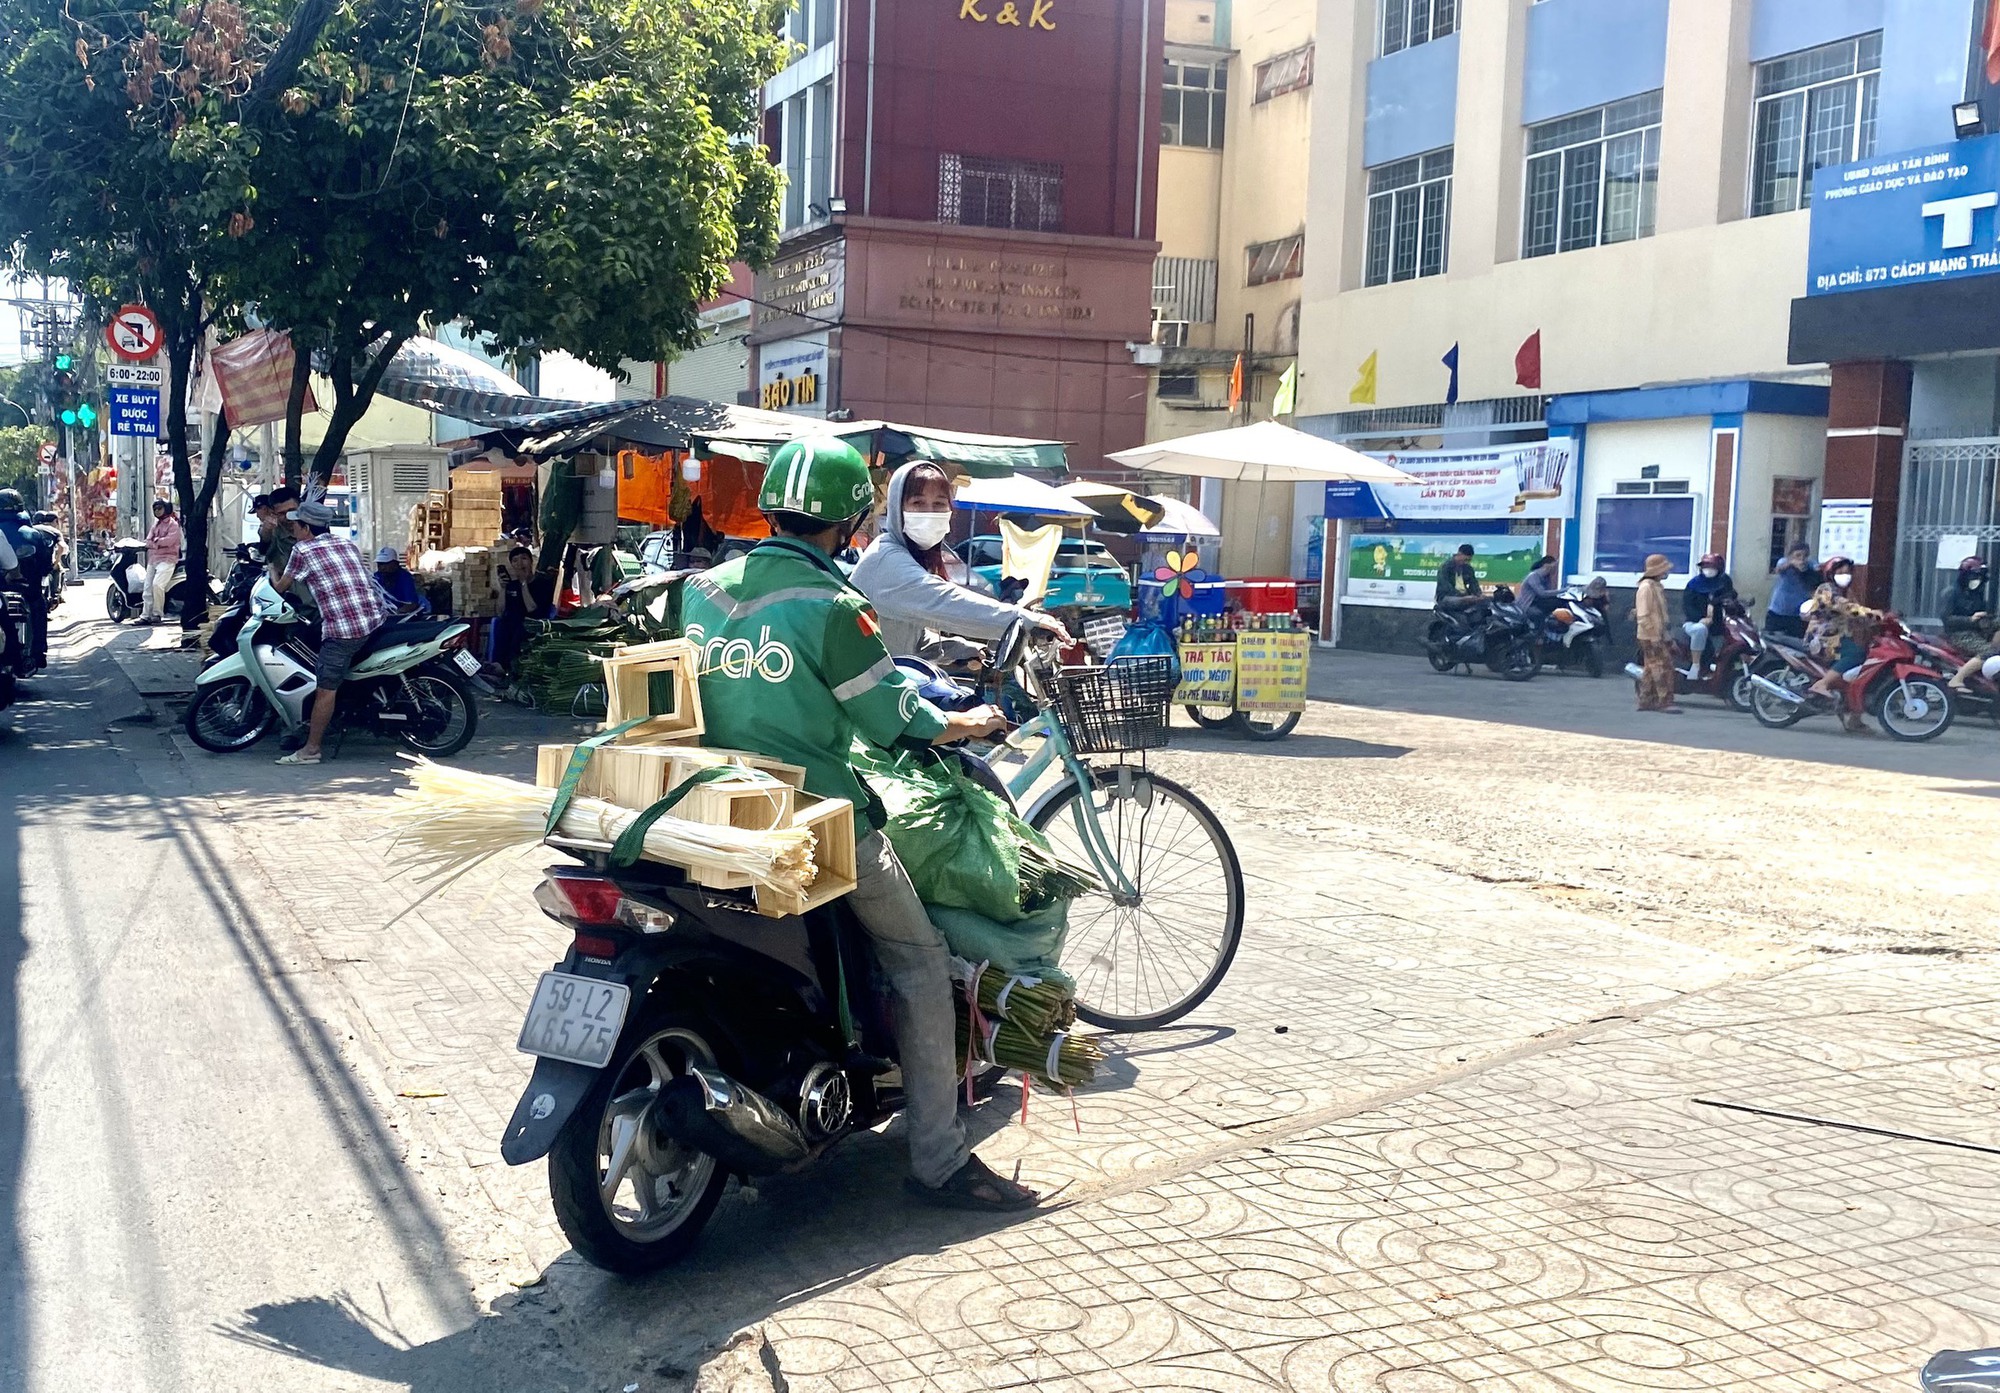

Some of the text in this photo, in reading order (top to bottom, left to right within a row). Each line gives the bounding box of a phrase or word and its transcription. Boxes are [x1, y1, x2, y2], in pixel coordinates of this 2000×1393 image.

[996, 2, 1021, 26] &
[1029, 0, 1056, 31] K
[1817, 274, 1837, 291] ĐỊA
[1891, 259, 1926, 279] CÁCH
[1929, 256, 1967, 276] MẠNG
[1971, 248, 2000, 268] THÁ
[109, 368, 130, 380] 6:00
[136, 370, 160, 382] 22:00
[115, 393, 129, 404] XE
[121, 407, 148, 421] ĐƯỢC
[584, 956, 612, 966] HONDA
[546, 979, 614, 1022] 59-L2
